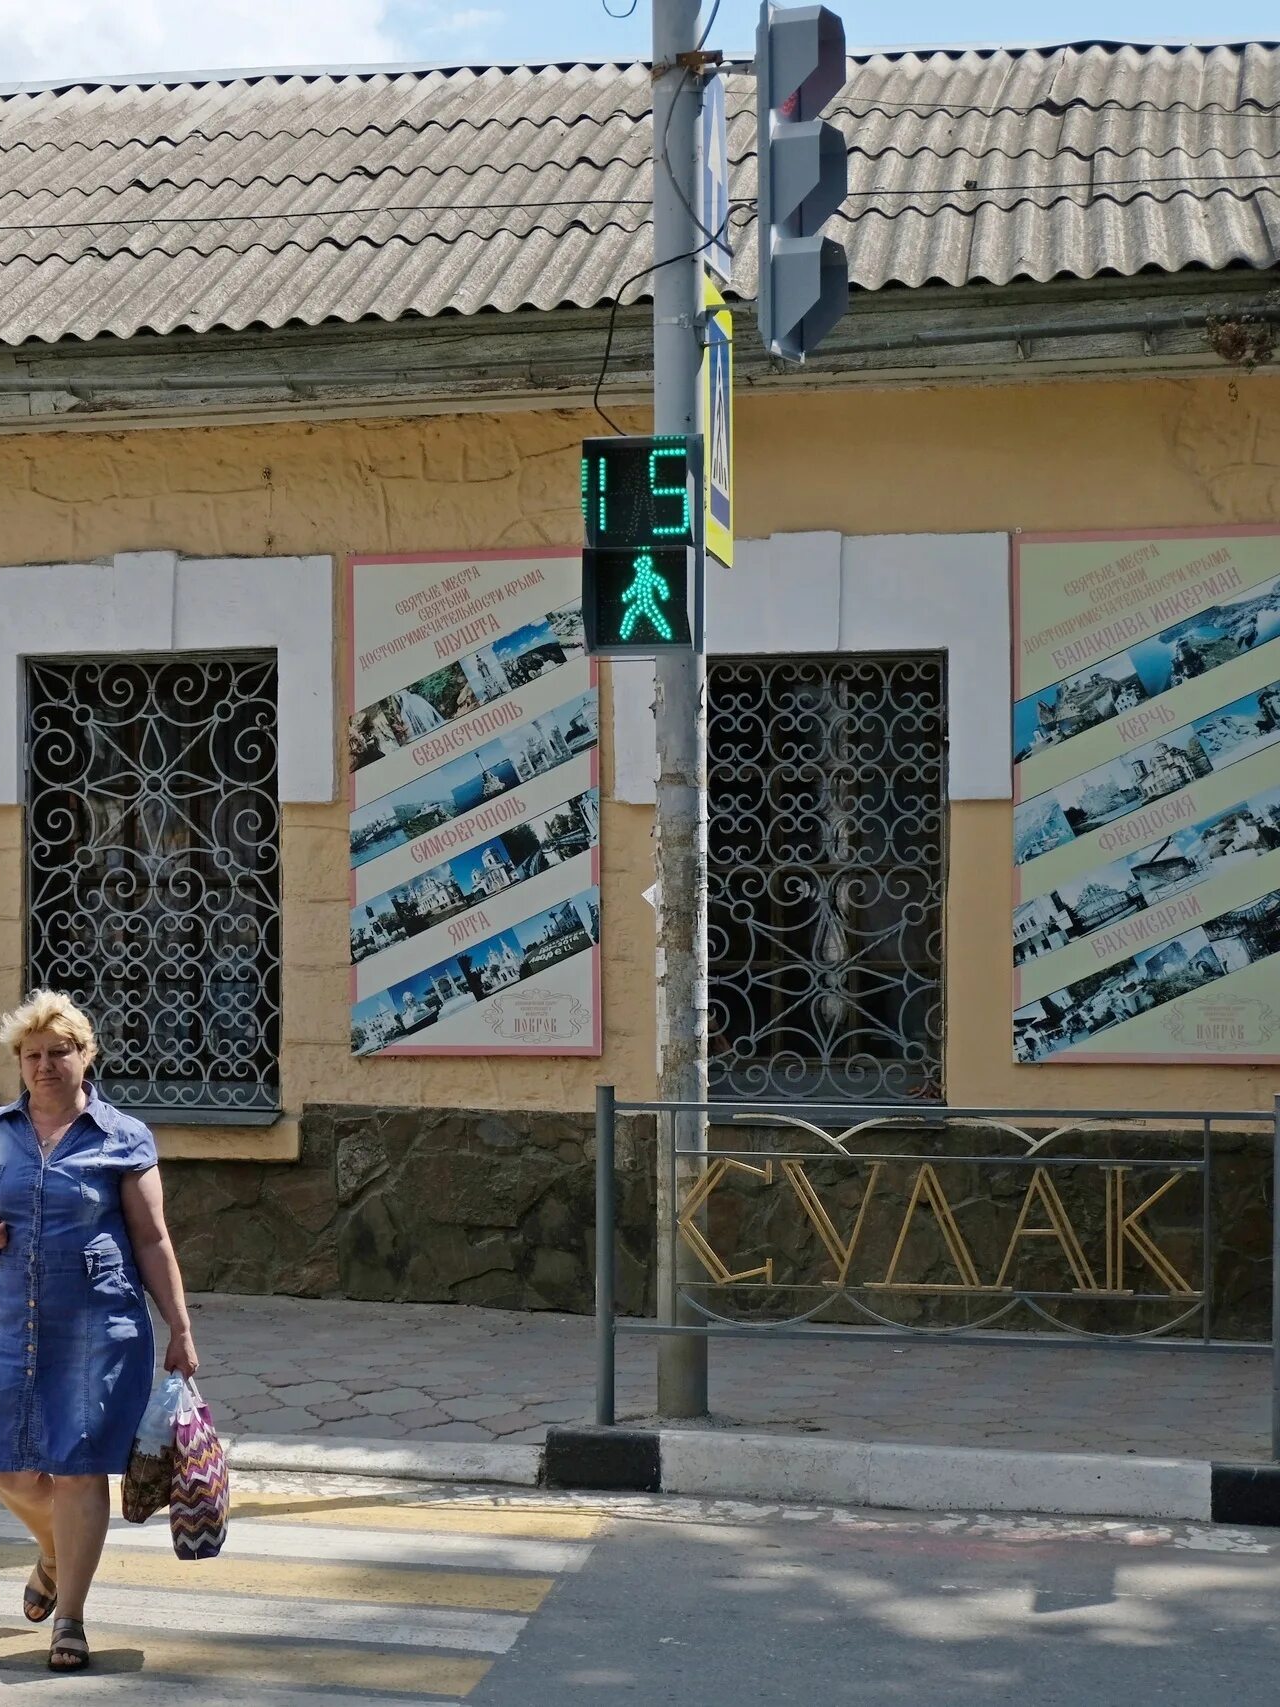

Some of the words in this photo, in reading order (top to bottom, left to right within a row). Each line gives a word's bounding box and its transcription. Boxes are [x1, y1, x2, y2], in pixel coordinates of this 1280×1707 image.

[599, 449, 689, 536] 15
[395, 583, 443, 616] СВЯТЫЕ
[441, 565, 481, 593] МЕСТА
[1063, 562, 1120, 597] СВЯТЫЕ
[1115, 543, 1161, 574] МЕСТА
[1088, 566, 1149, 604] СВЯТЫНИ
[358, 588, 505, 672] ДОСТОПРИМЕЧАТЕЛЬНОСТИ
[504, 568, 545, 597] КРЫМА
[418, 587, 471, 622] СВЯТЫНИ
[1023, 570, 1187, 655] ДОСТОПРИМЕЧАТЕЛЬНОСТИ
[1186, 547, 1232, 578] КРЫМА
[1050, 613, 1151, 670] БАЛАКЛАВА
[1151, 566, 1243, 624] ИНКЕРМАН
[433, 612, 501, 659] АЛУШТА
[411, 702, 524, 767] СЕВАСТОПОЛЬ
[1116, 704, 1176, 743] КЕРЧЬ
[410, 796, 527, 864] СИМФЕРОПОЛЬ
[1098, 794, 1198, 852] ФЕОДОСИЯ
[446, 910, 492, 946] ЯЛТА
[1089, 892, 1204, 959] БАХЧИСАРАЙ
